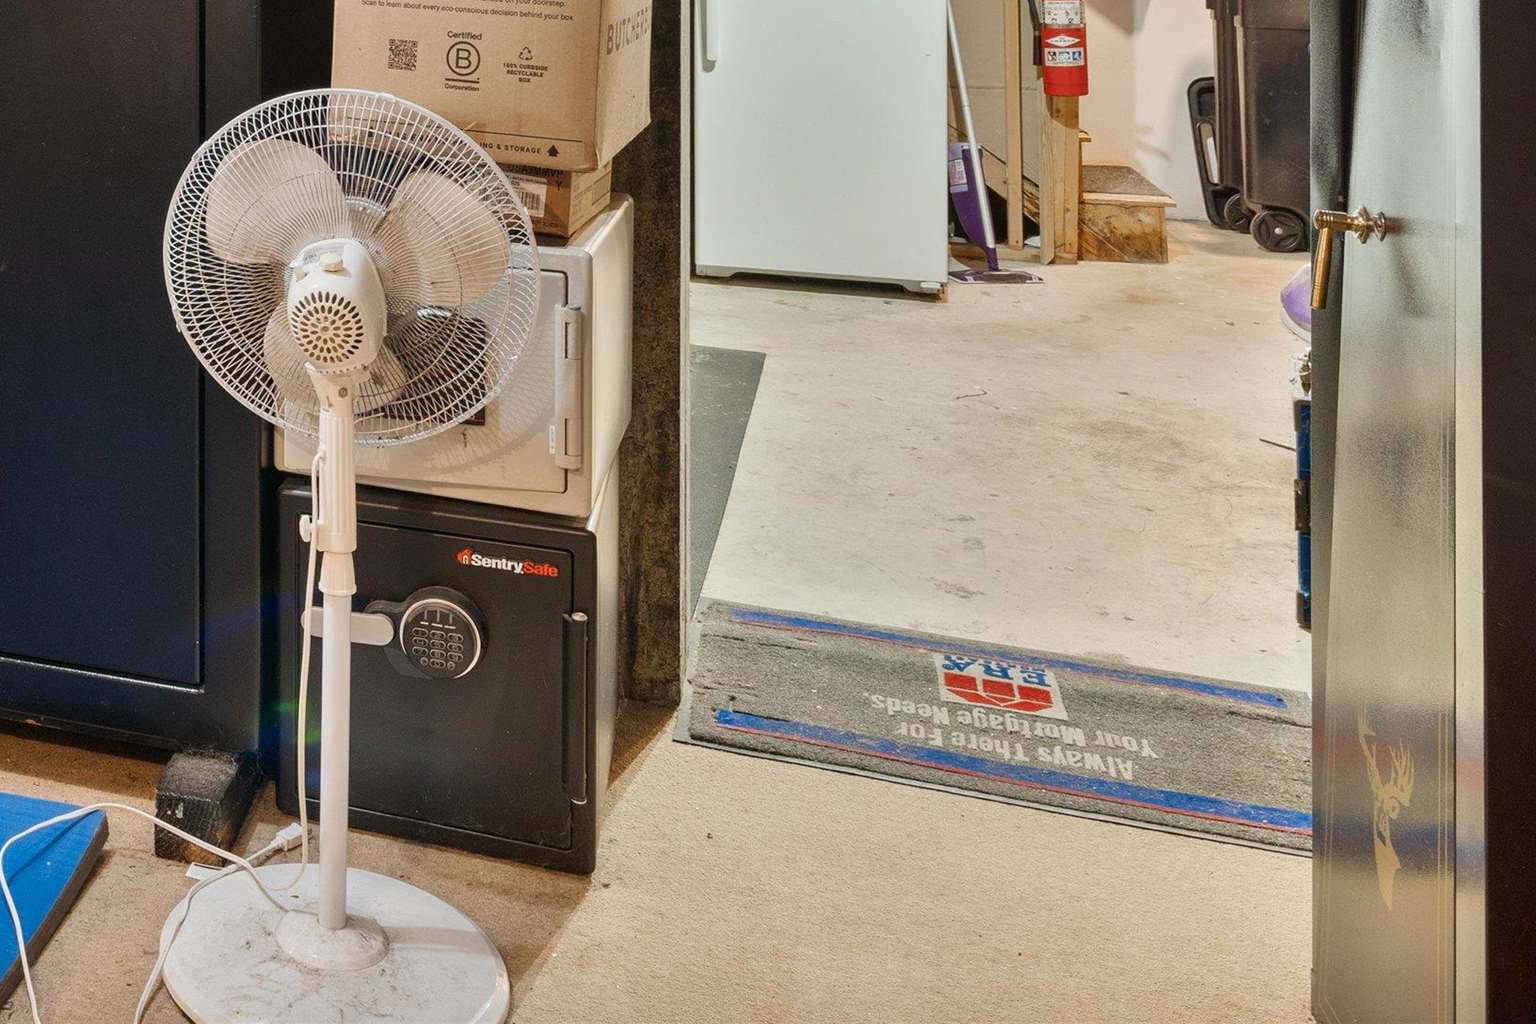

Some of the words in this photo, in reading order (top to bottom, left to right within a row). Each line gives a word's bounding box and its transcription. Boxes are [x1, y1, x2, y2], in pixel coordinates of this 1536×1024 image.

[386, 0, 402, 8] learn
[402, 1, 421, 10] about
[422, 4, 440, 12] every
[489, 7, 518, 17] decision
[519, 9, 543, 19] behind
[543, 12, 560, 21] your
[447, 30, 483, 41] Certified
[506, 69, 544, 78] RECYCLABLE
[444, 83, 480, 92] Corporation
[503, 144, 542, 155] STORAGE
[942, 655, 1052, 688] ERA
[894, 720, 944, 747] For
[955, 706, 1087, 748] Mortgage
[950, 732, 1030, 762] There
[1094, 729, 1159, 759] Your
[1037, 745, 1135, 781] Always
